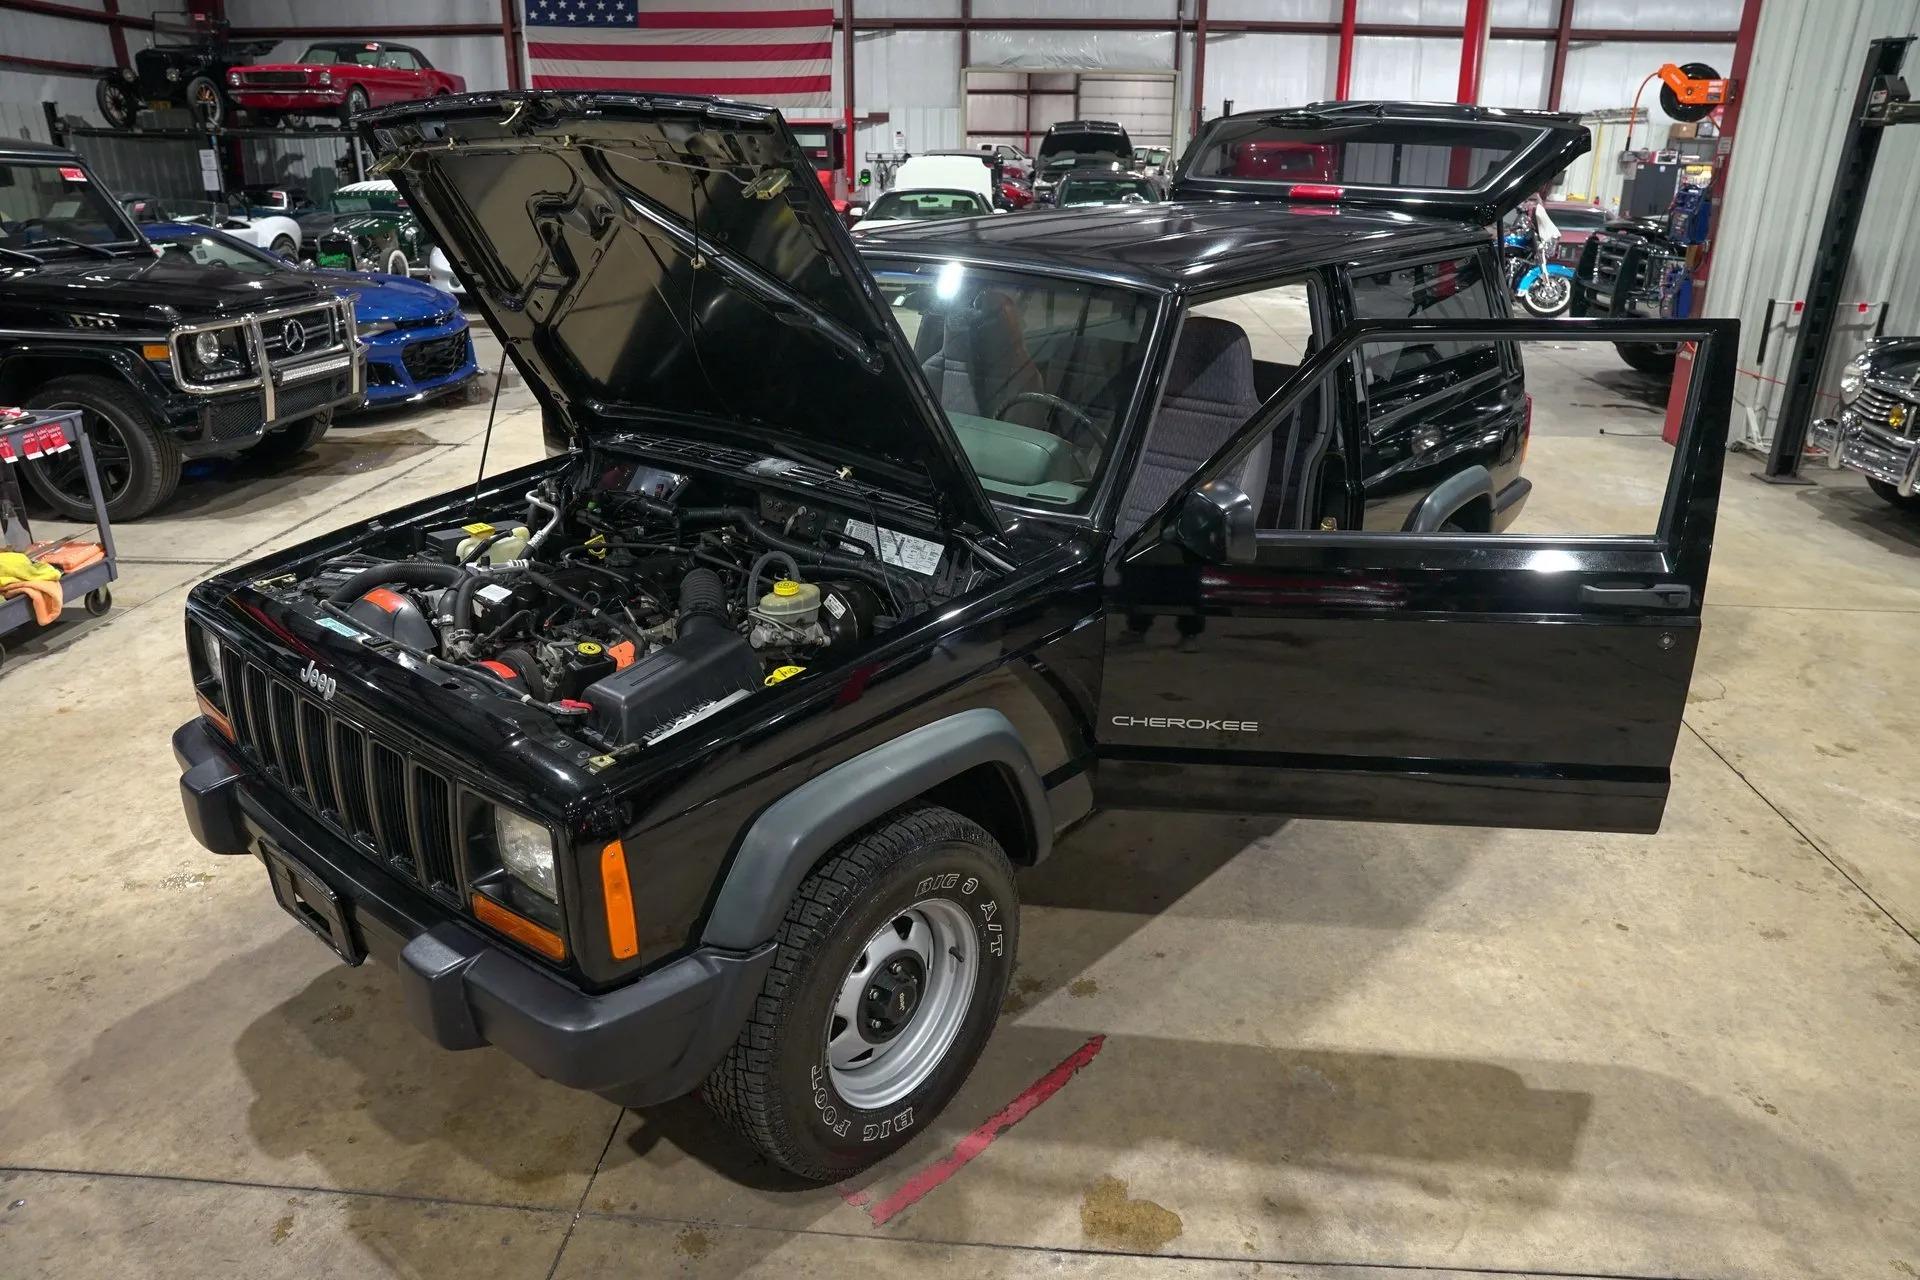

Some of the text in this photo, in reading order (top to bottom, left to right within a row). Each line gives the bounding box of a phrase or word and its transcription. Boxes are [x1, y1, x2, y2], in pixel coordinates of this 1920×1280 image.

[300, 660, 337, 701] Jeep
[1111, 715, 1259, 732] CHEROKEE
[914, 873, 961, 898] BIG
[811, 1065, 914, 1142] BIG FOOT
